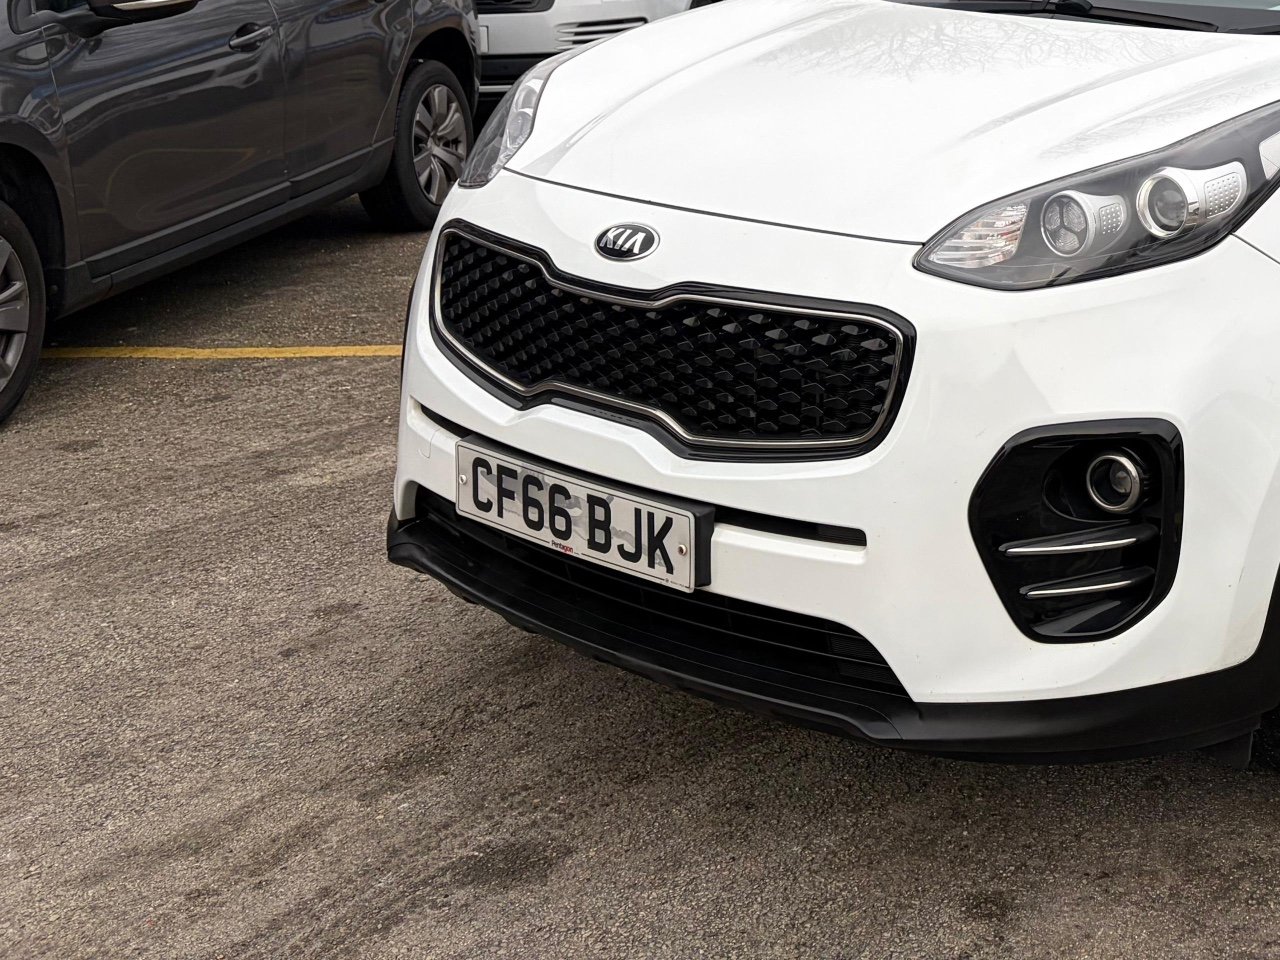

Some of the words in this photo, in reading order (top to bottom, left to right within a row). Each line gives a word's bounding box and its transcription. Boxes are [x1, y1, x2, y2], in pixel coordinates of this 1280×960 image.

[600, 227, 646, 254] KIA
[472, 456, 573, 542] CF66
[586, 493, 674, 575] BJK
[552, 539, 574, 553] Pentagon
